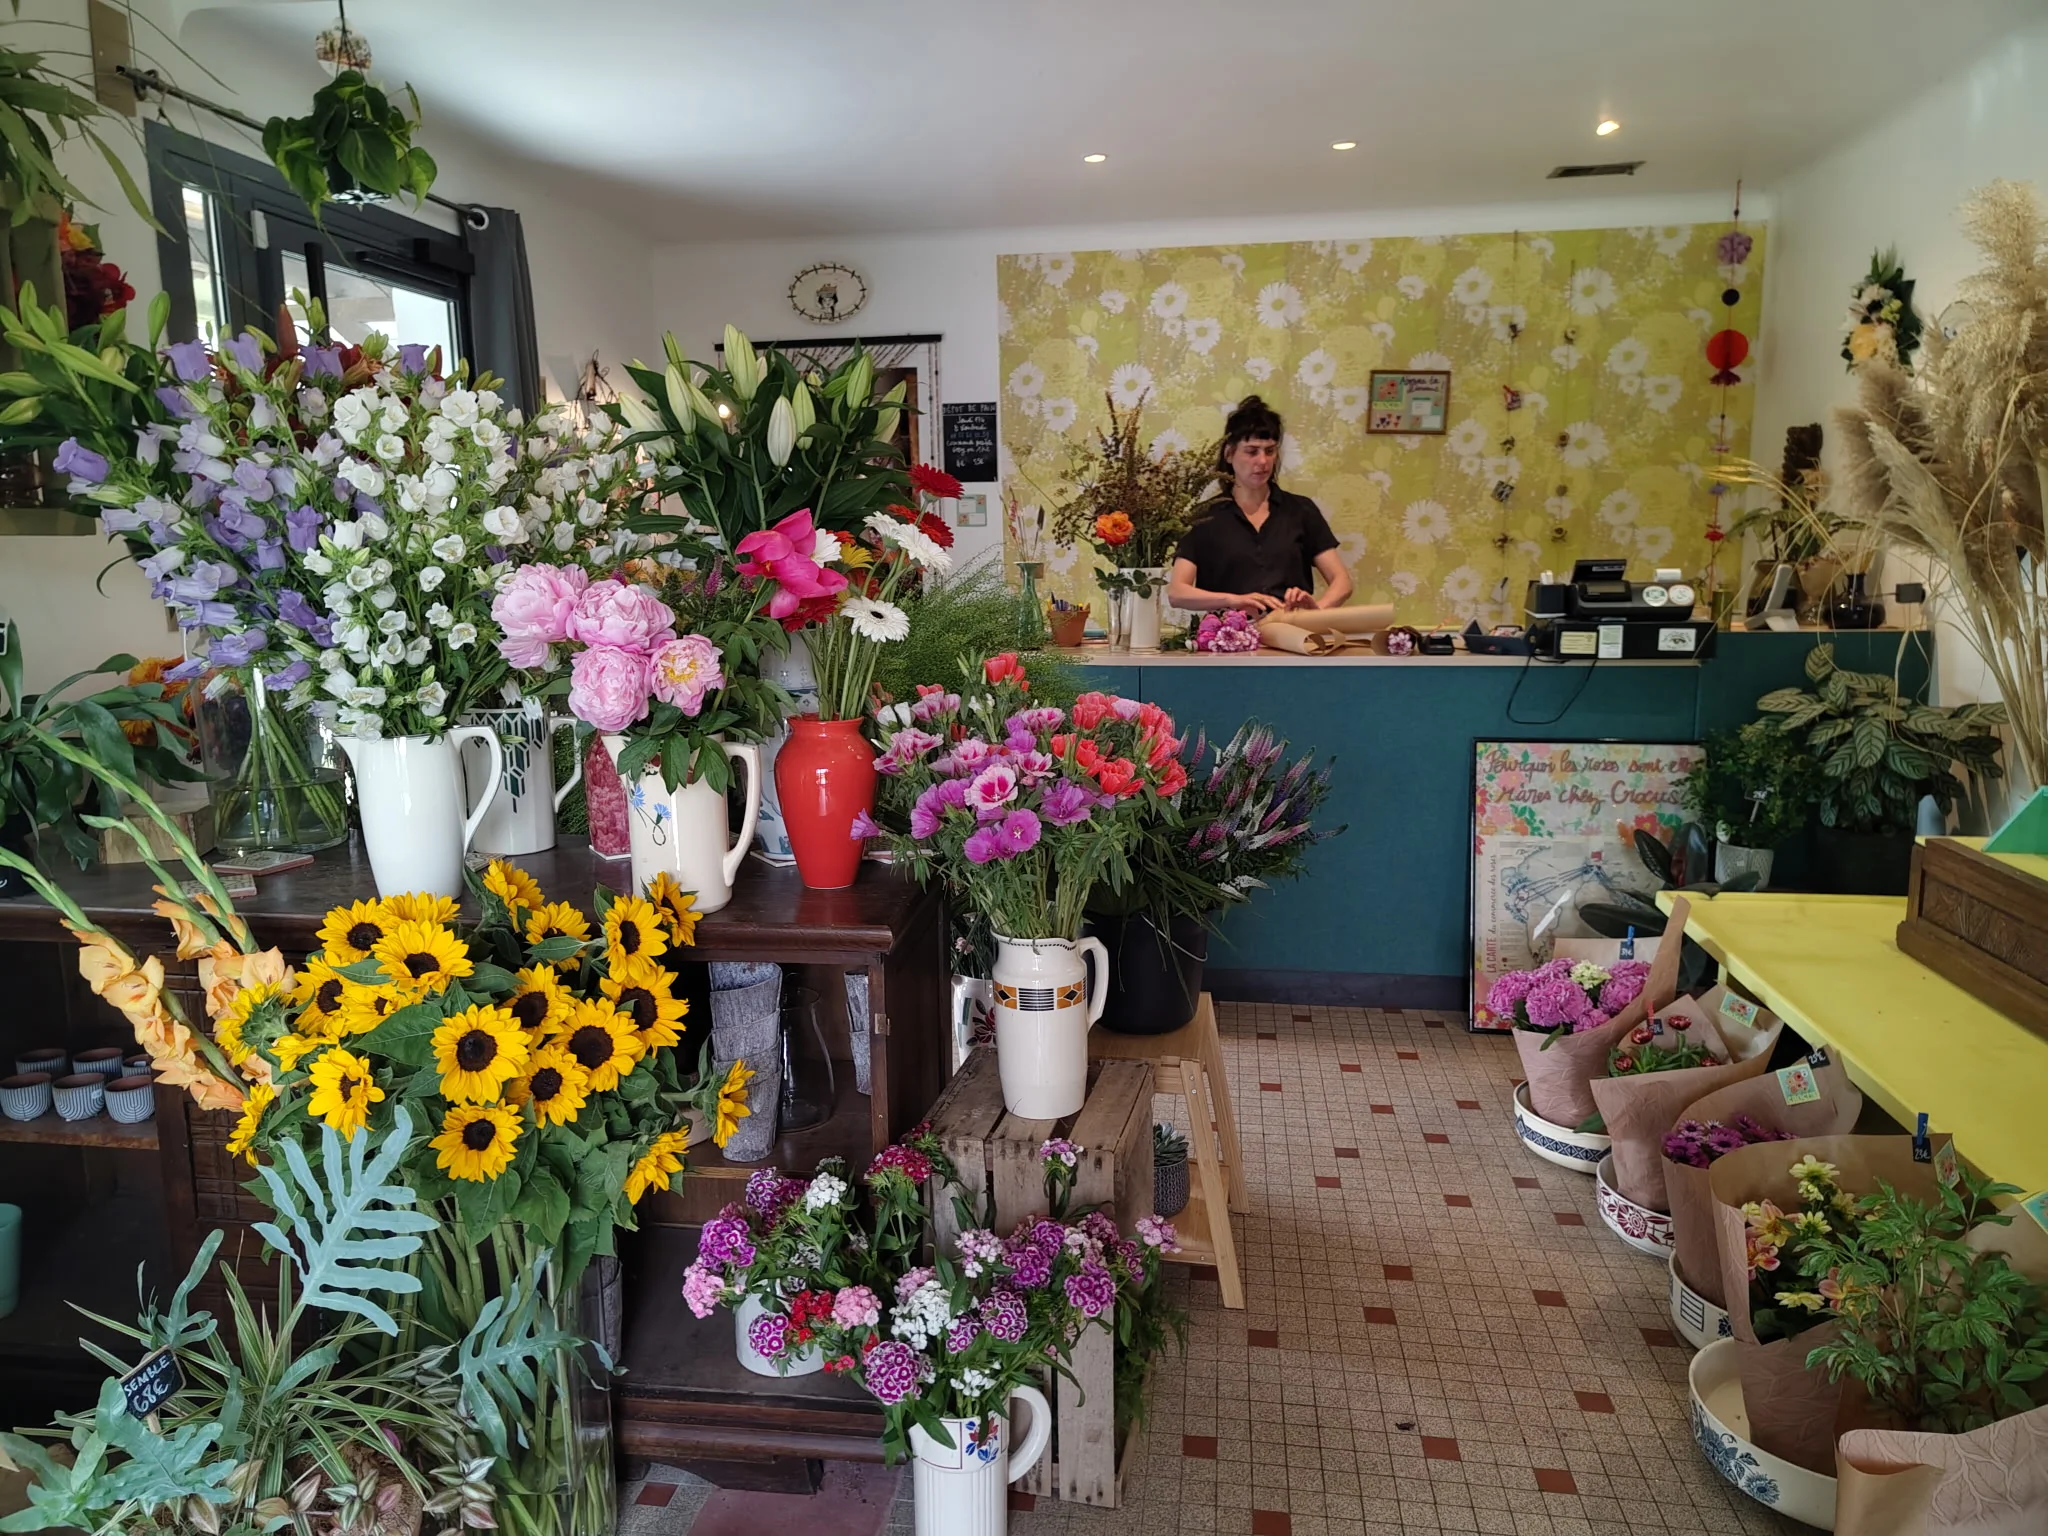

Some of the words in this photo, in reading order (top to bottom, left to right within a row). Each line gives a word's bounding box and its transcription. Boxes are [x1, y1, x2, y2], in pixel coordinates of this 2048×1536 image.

[1484, 750, 1556, 783] Pourquoi
[1560, 749, 1578, 772] les
[1582, 756, 1619, 773] roses
[1558, 784, 1606, 814] chez
[1487, 874, 1496, 886] des
[1488, 924, 1496, 934] du
[1486, 938, 1496, 962] CARTE
[1486, 964, 1496, 974] LA
[124, 1355, 170, 1397] SEMBLE
[133, 1378, 169, 1413] 68€
